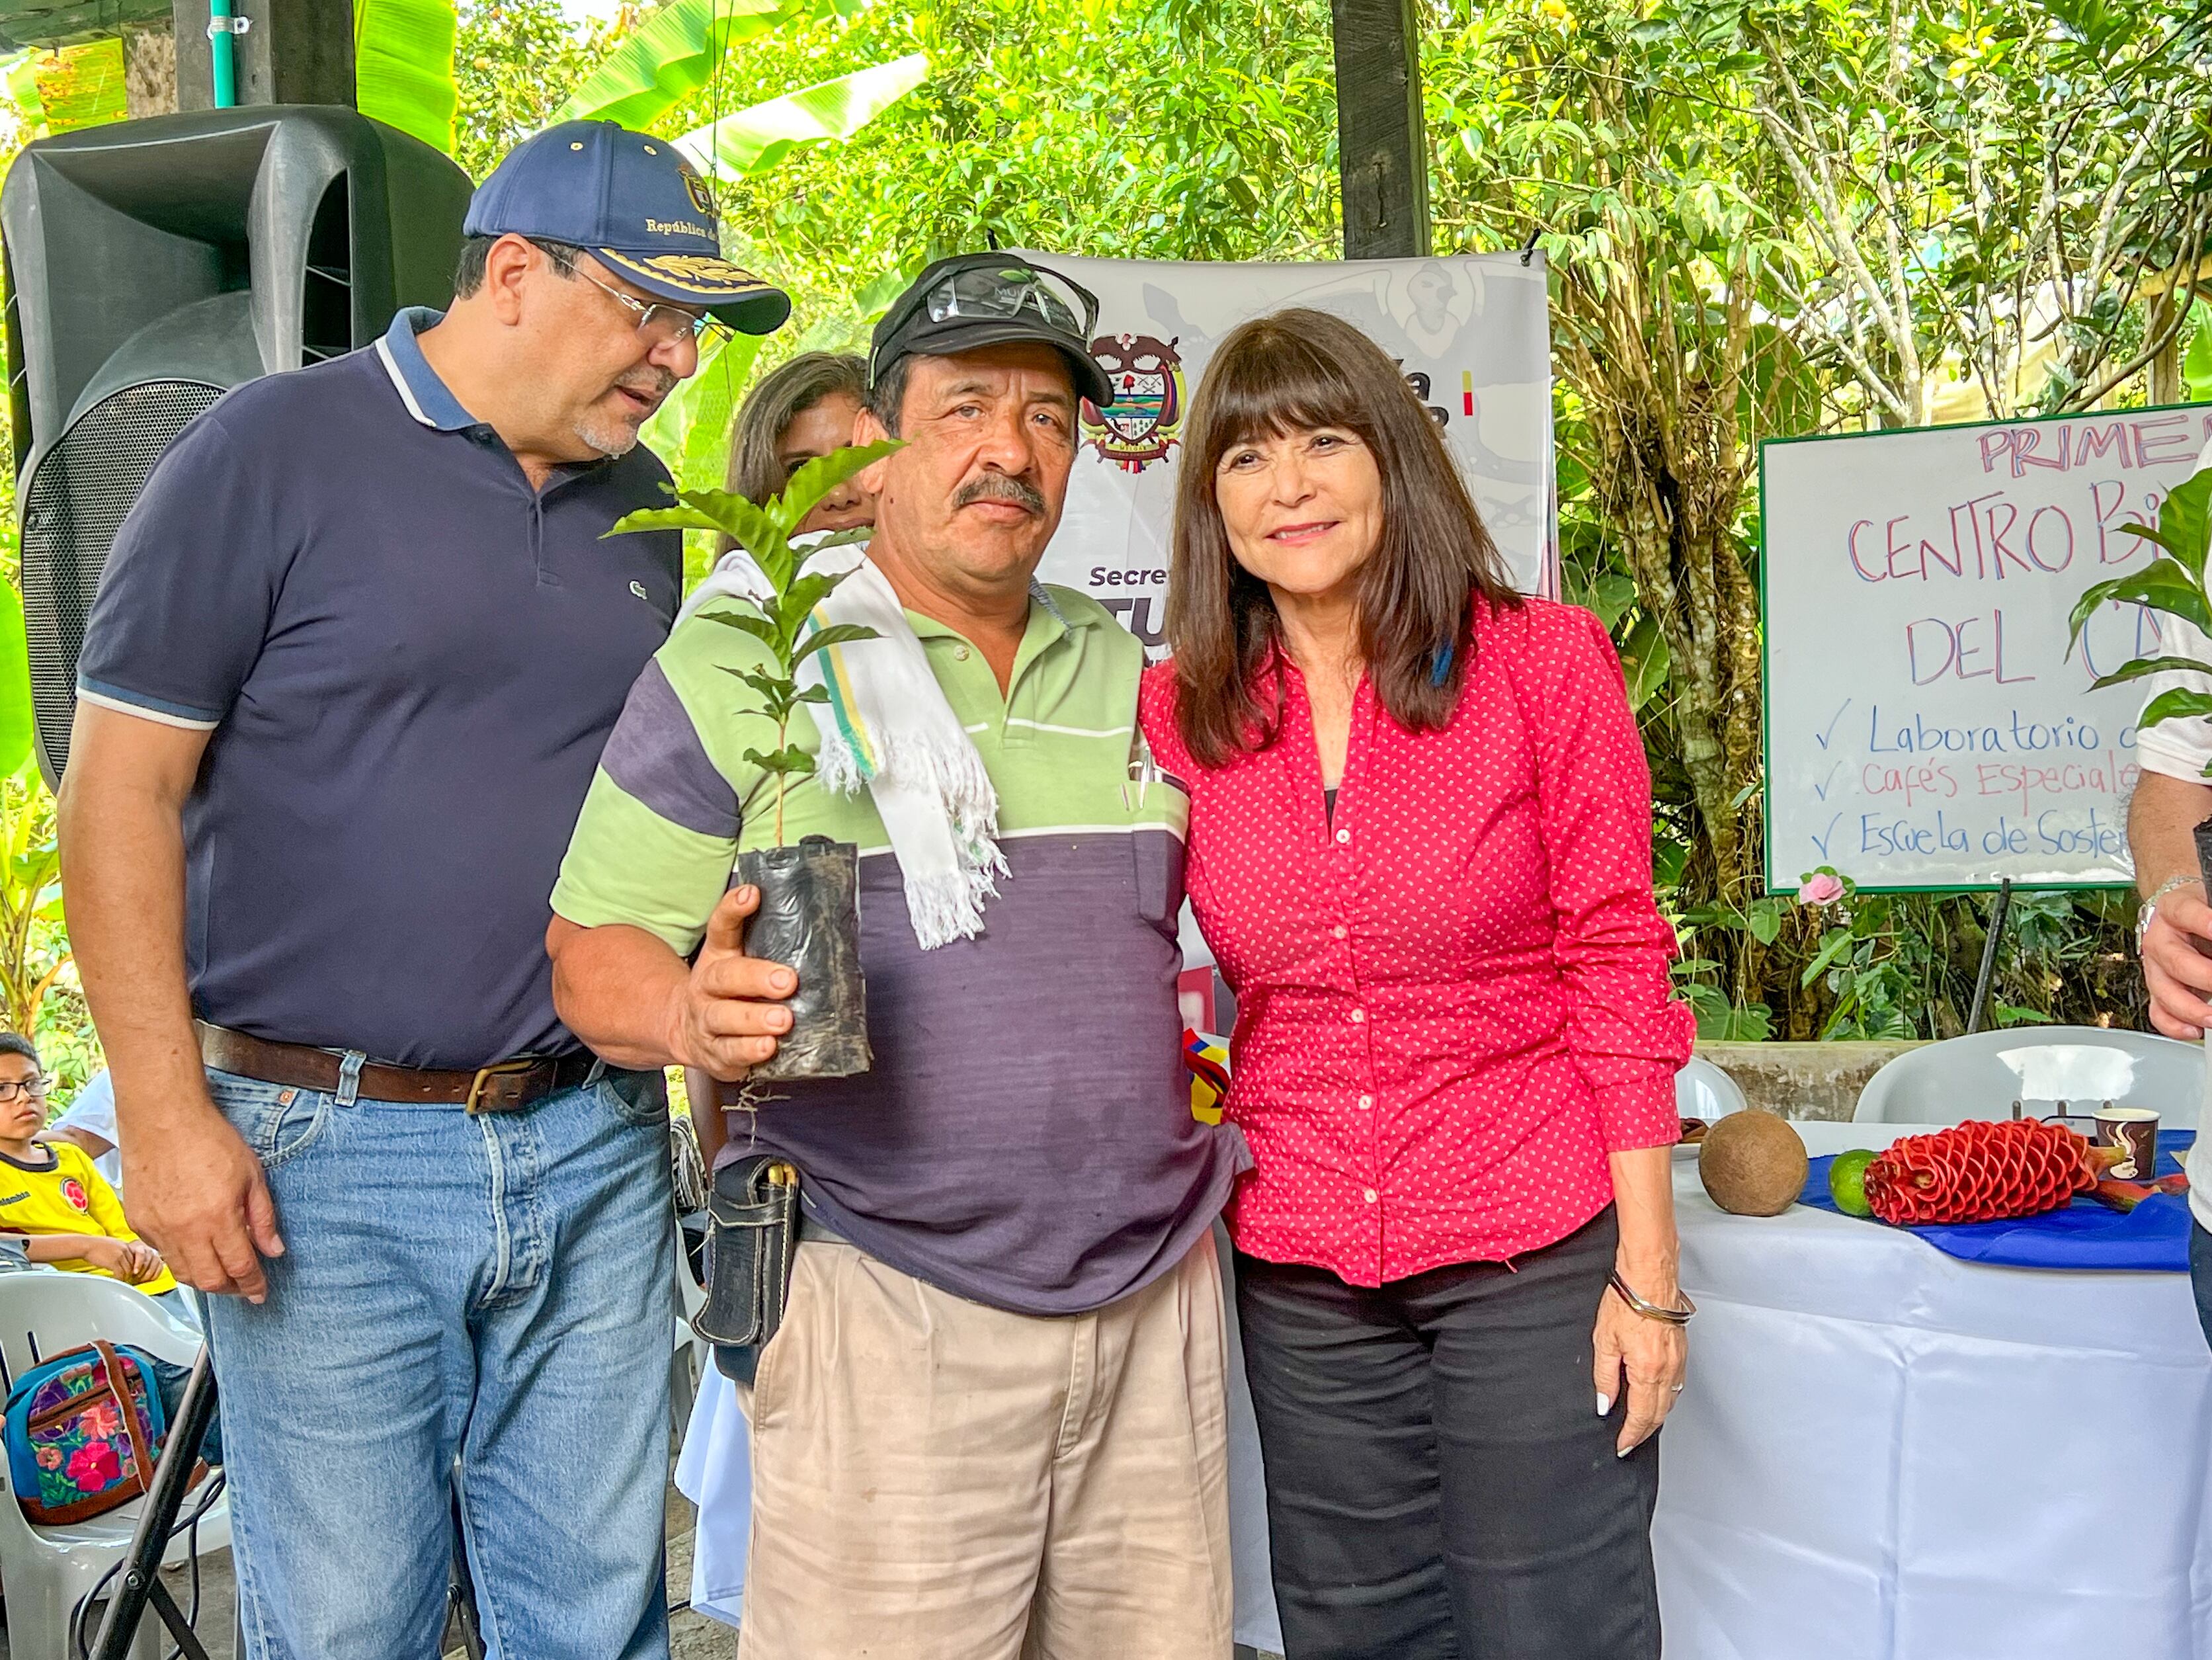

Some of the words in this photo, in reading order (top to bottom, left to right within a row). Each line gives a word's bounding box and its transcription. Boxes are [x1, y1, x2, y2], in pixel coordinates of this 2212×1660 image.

[1976, 414, 2212, 477] PRIME
[1848, 491, 2074, 582] CENTRO
[1089, 566, 1167, 587] Secre
[1906, 608, 2035, 686] DEL
[1870, 704, 2099, 753] Laboratorio
[1862, 757, 1957, 808] Cafés
[1983, 816, 2028, 854] de
